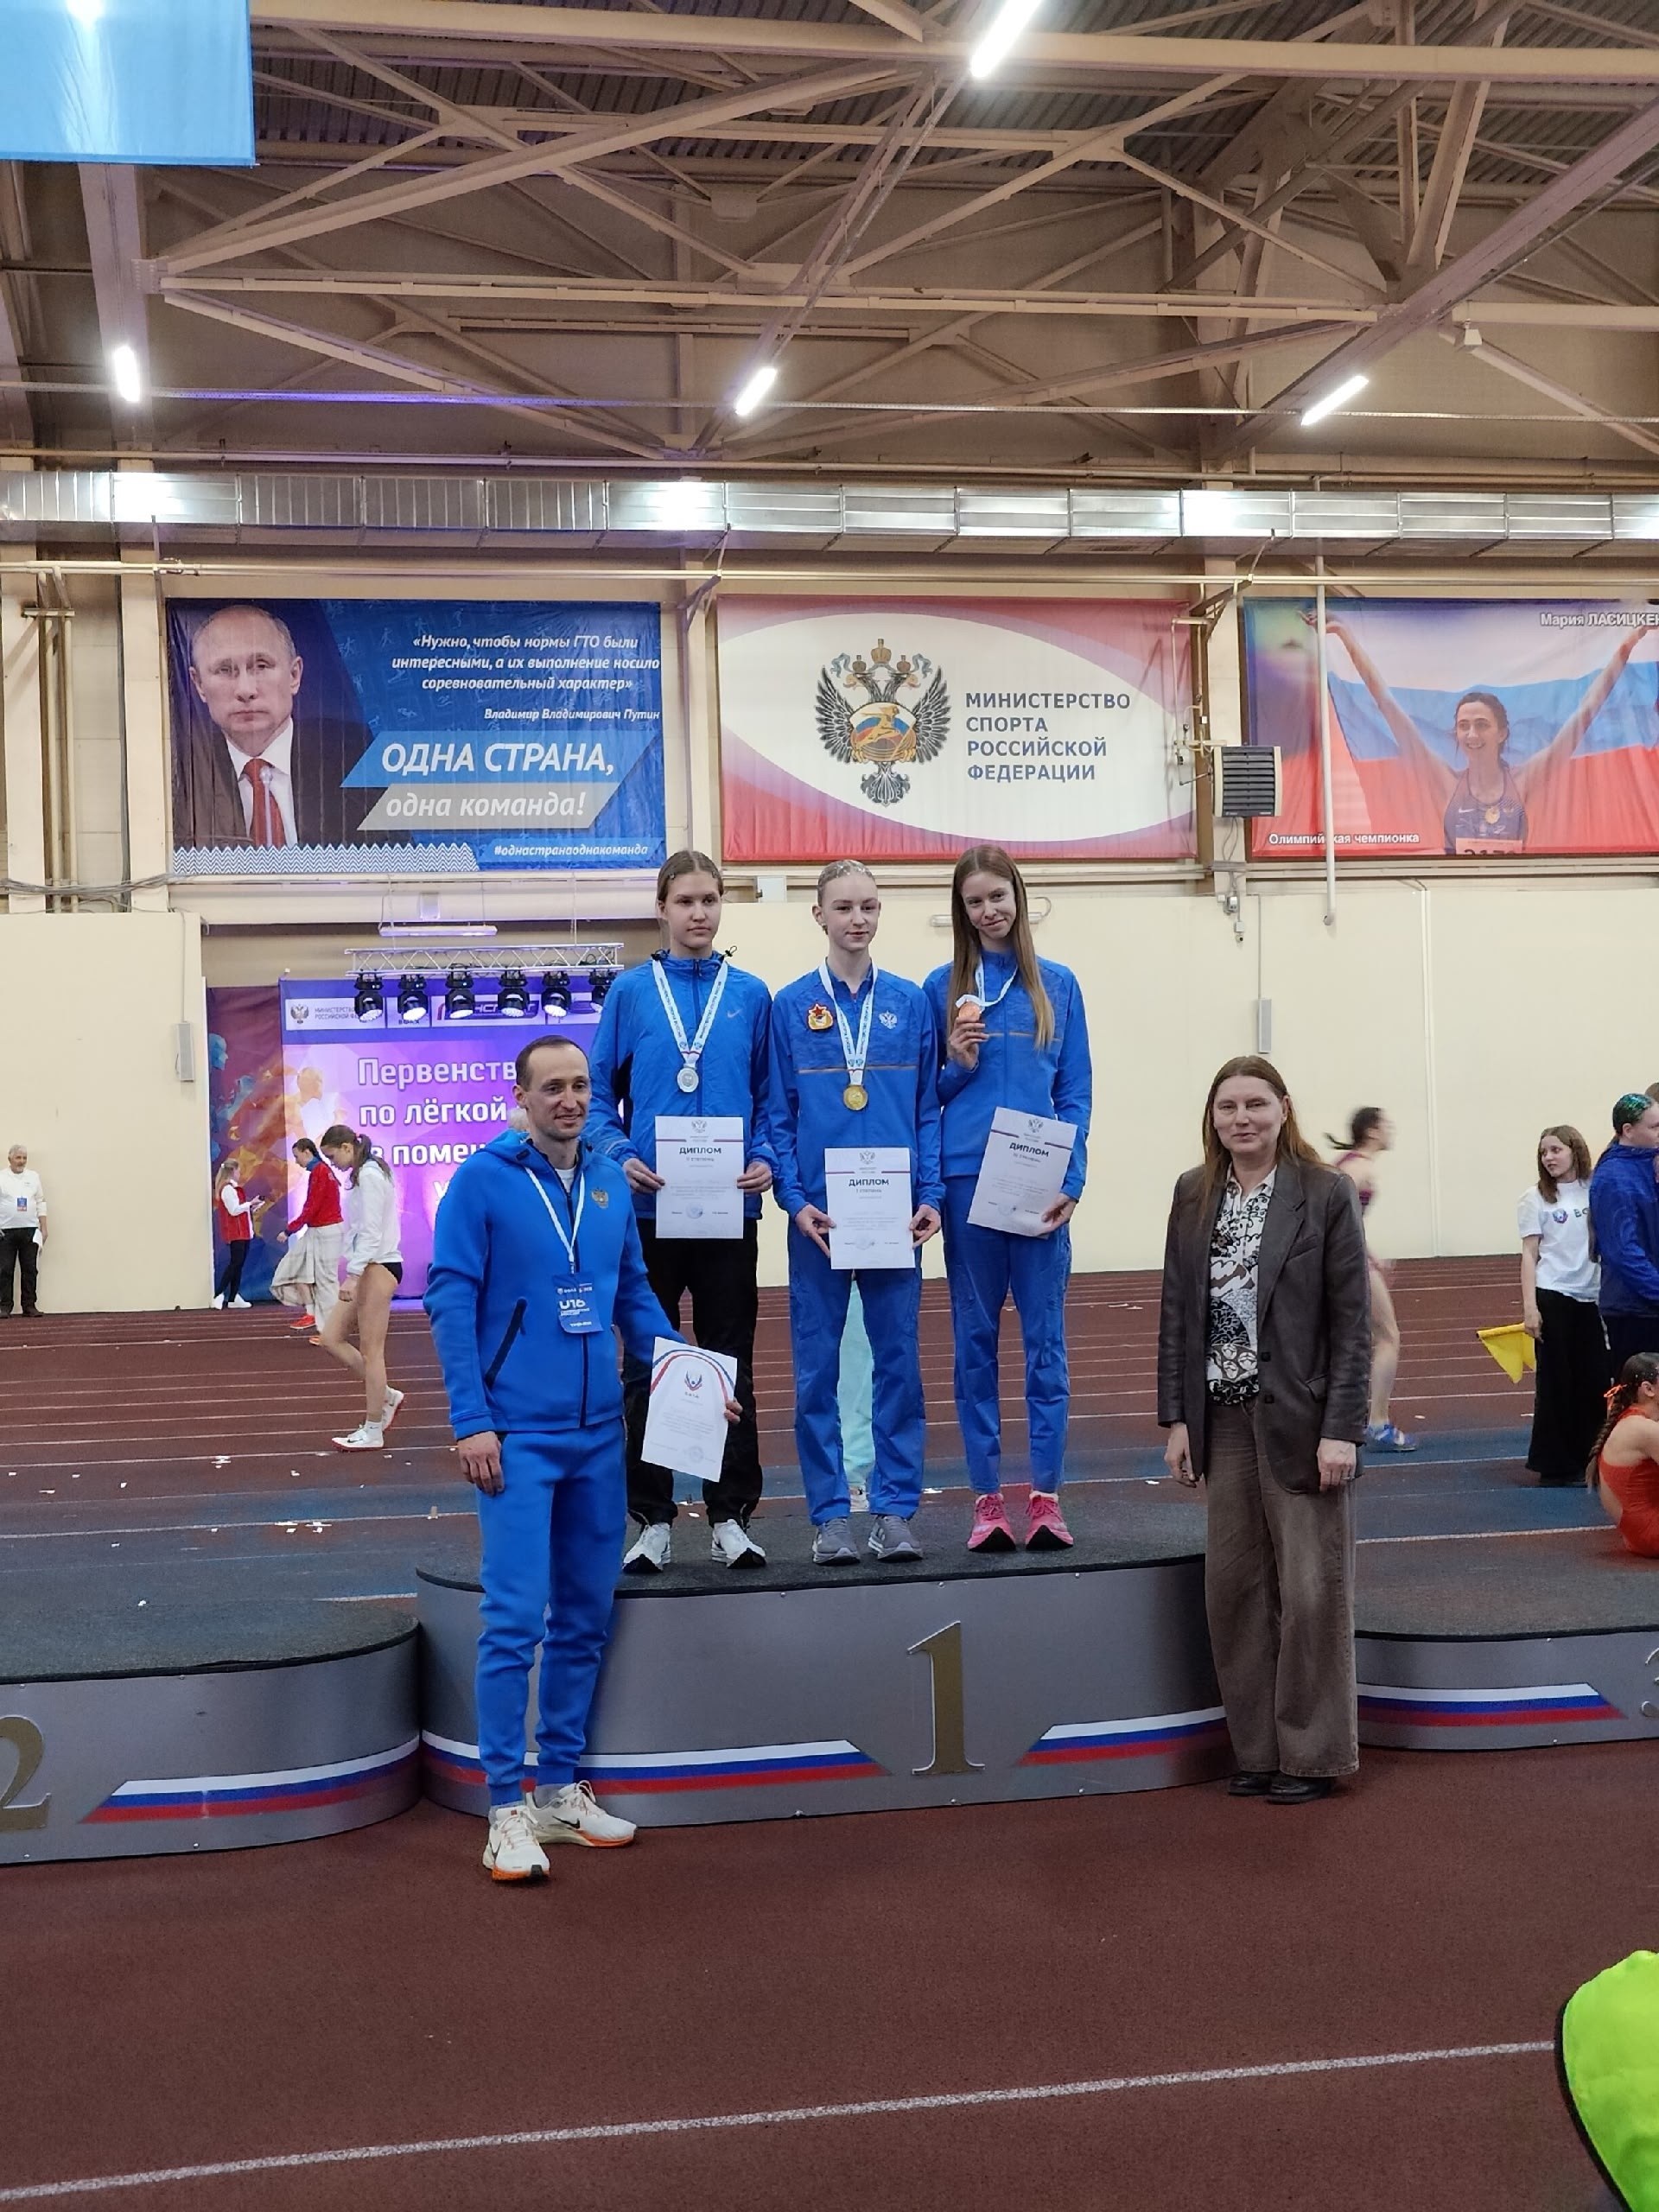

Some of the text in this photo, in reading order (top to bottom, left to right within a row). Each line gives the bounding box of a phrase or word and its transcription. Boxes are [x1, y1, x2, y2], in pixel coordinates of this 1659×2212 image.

[1540, 613, 1586, 630] Мария
[413, 634, 639, 651] «Нужно, чтобы нормы ГТО были
[391, 658, 660, 671] интересными, а их выполнение носило
[422, 677, 632, 692] соревновательный характер»
[965, 692, 1130, 709] МИНИСТЕРСТВО
[484, 708, 660, 721] Владимир Владимирович Путин
[966, 716, 1048, 733] СПОРТА
[967, 736, 1107, 757] РОССИЙСКОЙ
[382, 742, 614, 776] ОДНА СТРАНА,
[967, 764, 1096, 784] ФЕДЕРАЦИИ
[385, 791, 587, 817] одна команда!
[1268, 832, 1420, 845] Олимпийкая чемпионка
[494, 843, 648, 858] #однастранаоднакоманда
[358, 1057, 518, 1090] Первенств
[359, 1095, 508, 1126] по лёгкой
[392, 1143, 486, 1166] поме
[678, 1147, 722, 1155] ДИПЛОМ
[1008, 1141, 1050, 1158] ДИПЛОМ
[849, 1179, 889, 1187] ДИПЛОМ
[559, 1299, 586, 1310] U16
[907, 1620, 985, 1776] 1
[0, 1714, 52, 1832] 2
